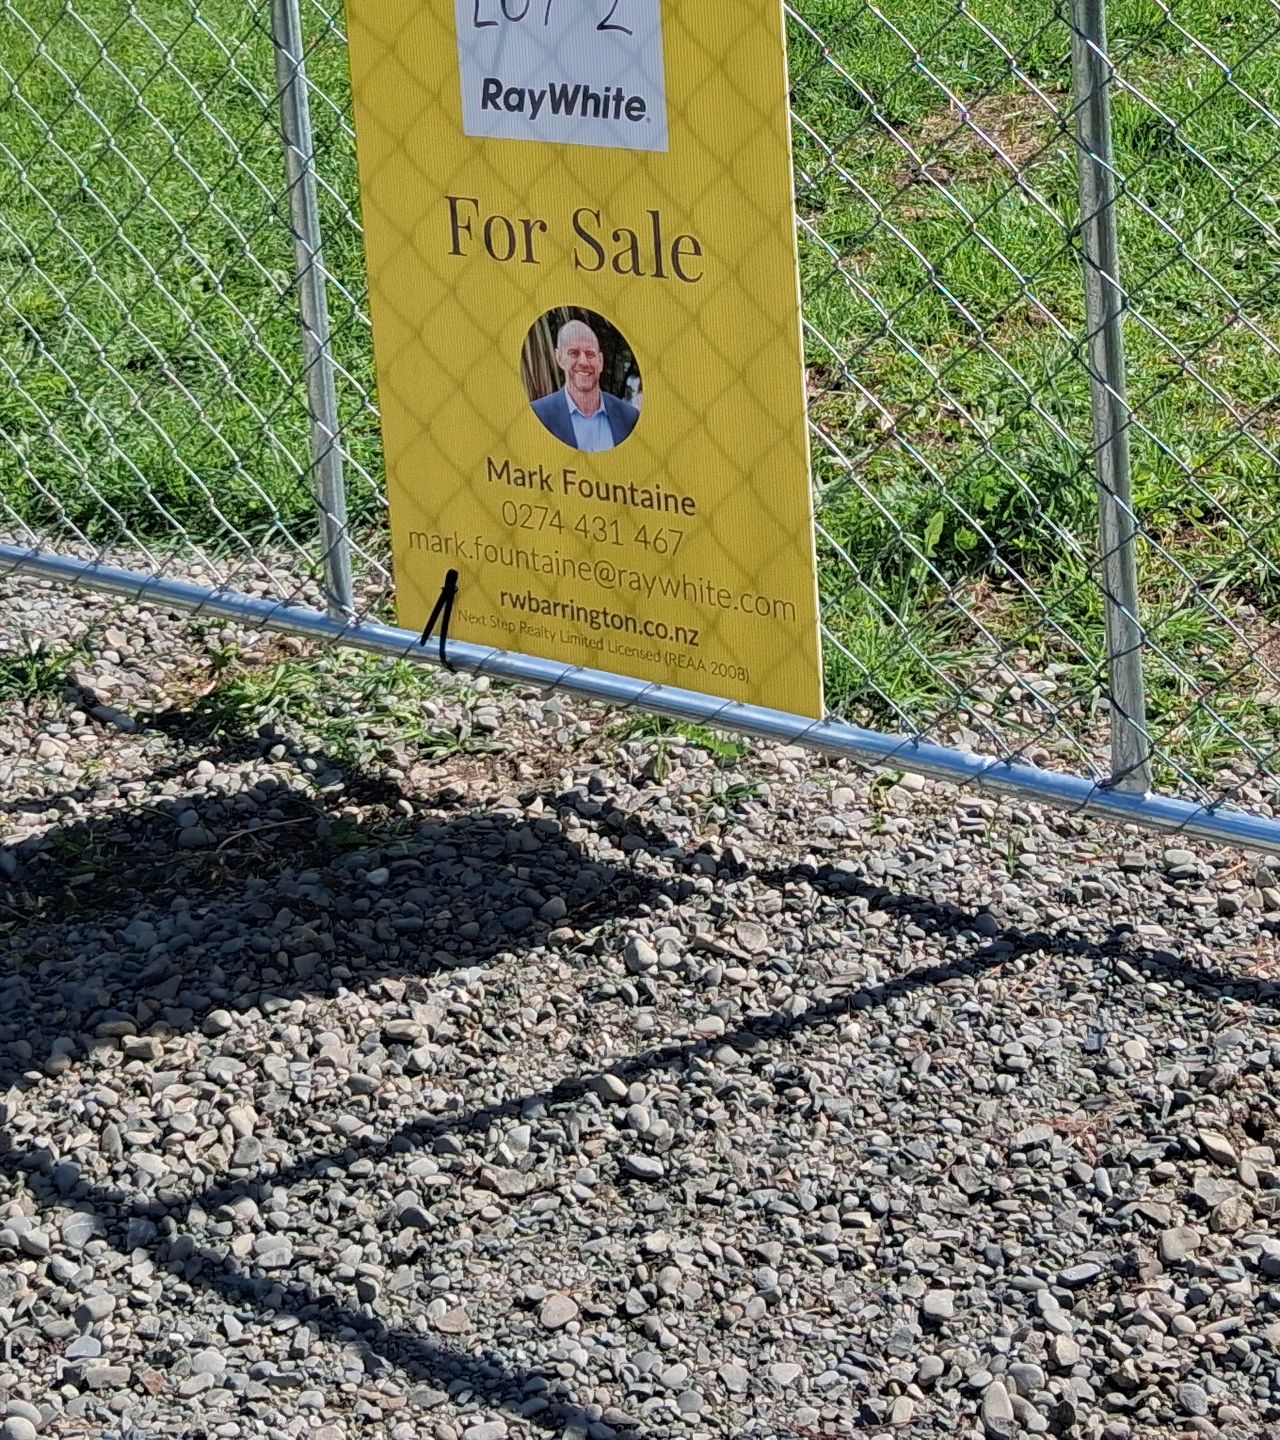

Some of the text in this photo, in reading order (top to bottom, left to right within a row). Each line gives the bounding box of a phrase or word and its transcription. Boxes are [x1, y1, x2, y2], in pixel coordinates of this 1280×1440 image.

[444, 195, 704, 283] For Sale
[487, 456, 697, 517] Mark Fountaine
[502, 500, 685, 557] 0274 431 467
[408, 530, 797, 622] mark.fountaine@raywhite.com
[456, 609, 750, 684] Next Step Realty Limited Licensed (REAA 2008)
[500, 589, 700, 647] rwbarrington.co.nz
